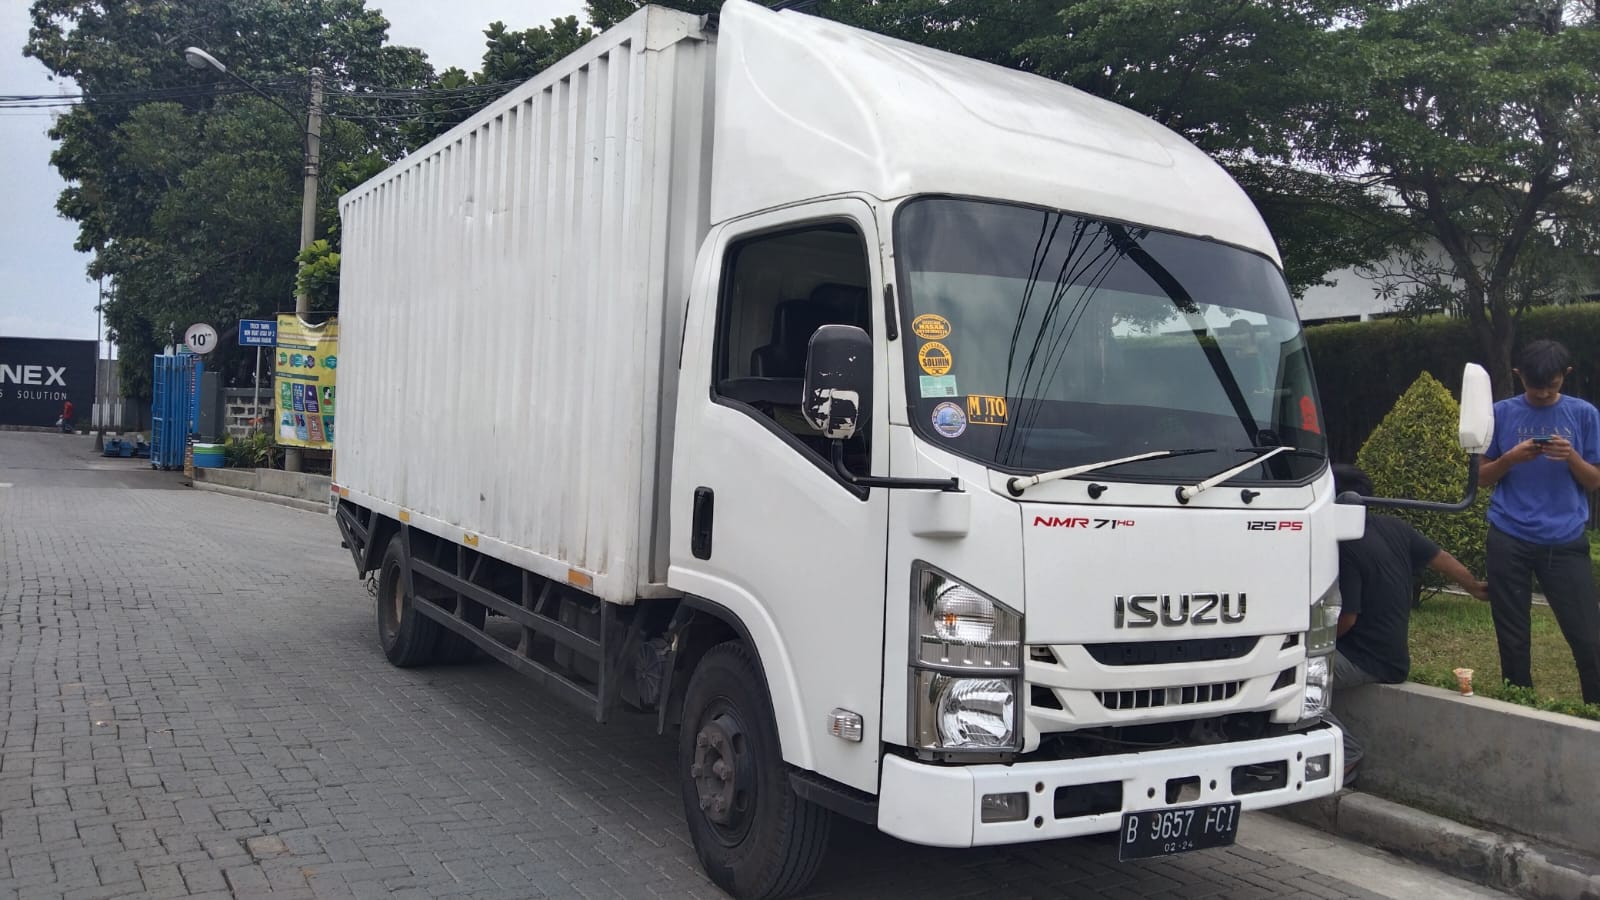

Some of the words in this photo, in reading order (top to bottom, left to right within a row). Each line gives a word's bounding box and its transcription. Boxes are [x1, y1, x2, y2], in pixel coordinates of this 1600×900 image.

[190, 334, 206, 346] 10
[17, 390, 67, 401] SOLUTION
[1033, 516, 1090, 528] NMR
[1113, 591, 1247, 629] ISUZU
[1126, 815, 1139, 844] B
[1150, 809, 1195, 840] 9657
[1204, 804, 1236, 834] FCI
